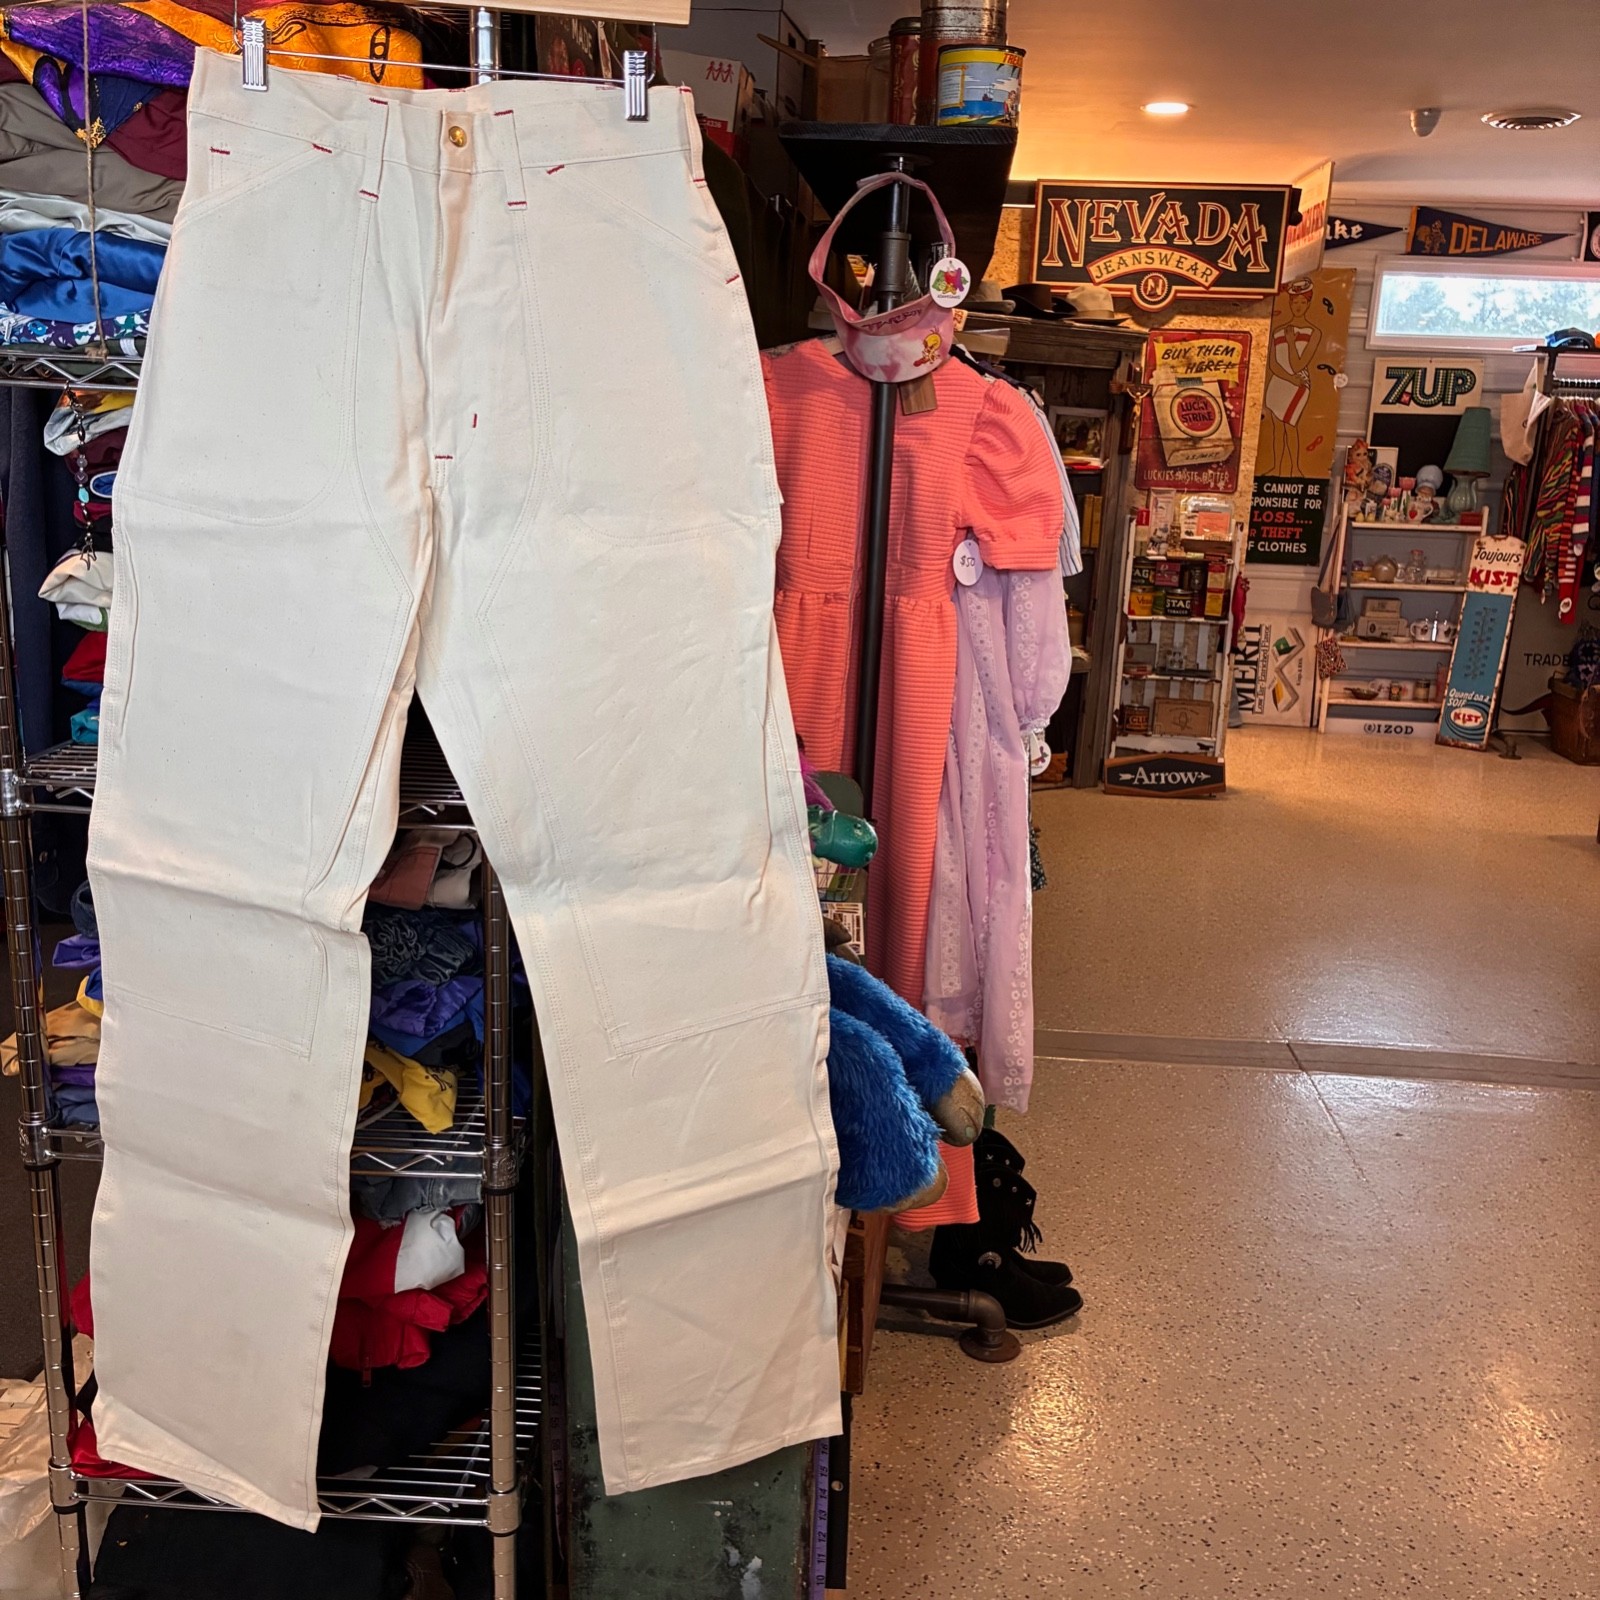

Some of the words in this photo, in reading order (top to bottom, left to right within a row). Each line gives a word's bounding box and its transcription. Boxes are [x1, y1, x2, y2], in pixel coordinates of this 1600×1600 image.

[1041, 192, 1270, 272] NEVADA
[1448, 222, 1543, 254] DELAWARE
[1094, 251, 1213, 283] JEANSWEAR
[1162, 347, 1191, 360] BUY
[1197, 345, 1236, 358] THEM
[1381, 367, 1477, 408] 7UP
[1181, 401, 1209, 412] LUCKY
[1181, 411, 1213, 423] STRIKE
[1143, 470, 1174, 481] LUCKIES
[1263, 482, 1304, 494] CANNOT
[1307, 484, 1320, 495] BE
[1251, 497, 1299, 509] SPONSIBLE
[1304, 498, 1322, 509] FOR
[1261, 526, 1303, 539] THEFT
[1248, 541, 1255, 551] F
[1257, 541, 1307, 553] CLOTHES
[960, 555, 975, 568] $50
[1474, 547, 1522, 565] Toujours
[1133, 569, 1149, 578] AG
[1469, 567, 1518, 588] KIST
[1166, 599, 1191, 608] STAG
[1449, 688, 1474, 700] Quand
[1453, 712, 1482, 724] KIST
[1376, 724, 1414, 735] IZOD
[1132, 767, 1199, 785] Arrow
[820, 1467, 828, 1477] 15
[819, 1488, 828, 1499] 14
[819, 1510, 827, 1521] 13
[818, 1531, 826, 1543] 12
[817, 1553, 826, 1564] 11
[816, 1575, 825, 1586] 10
